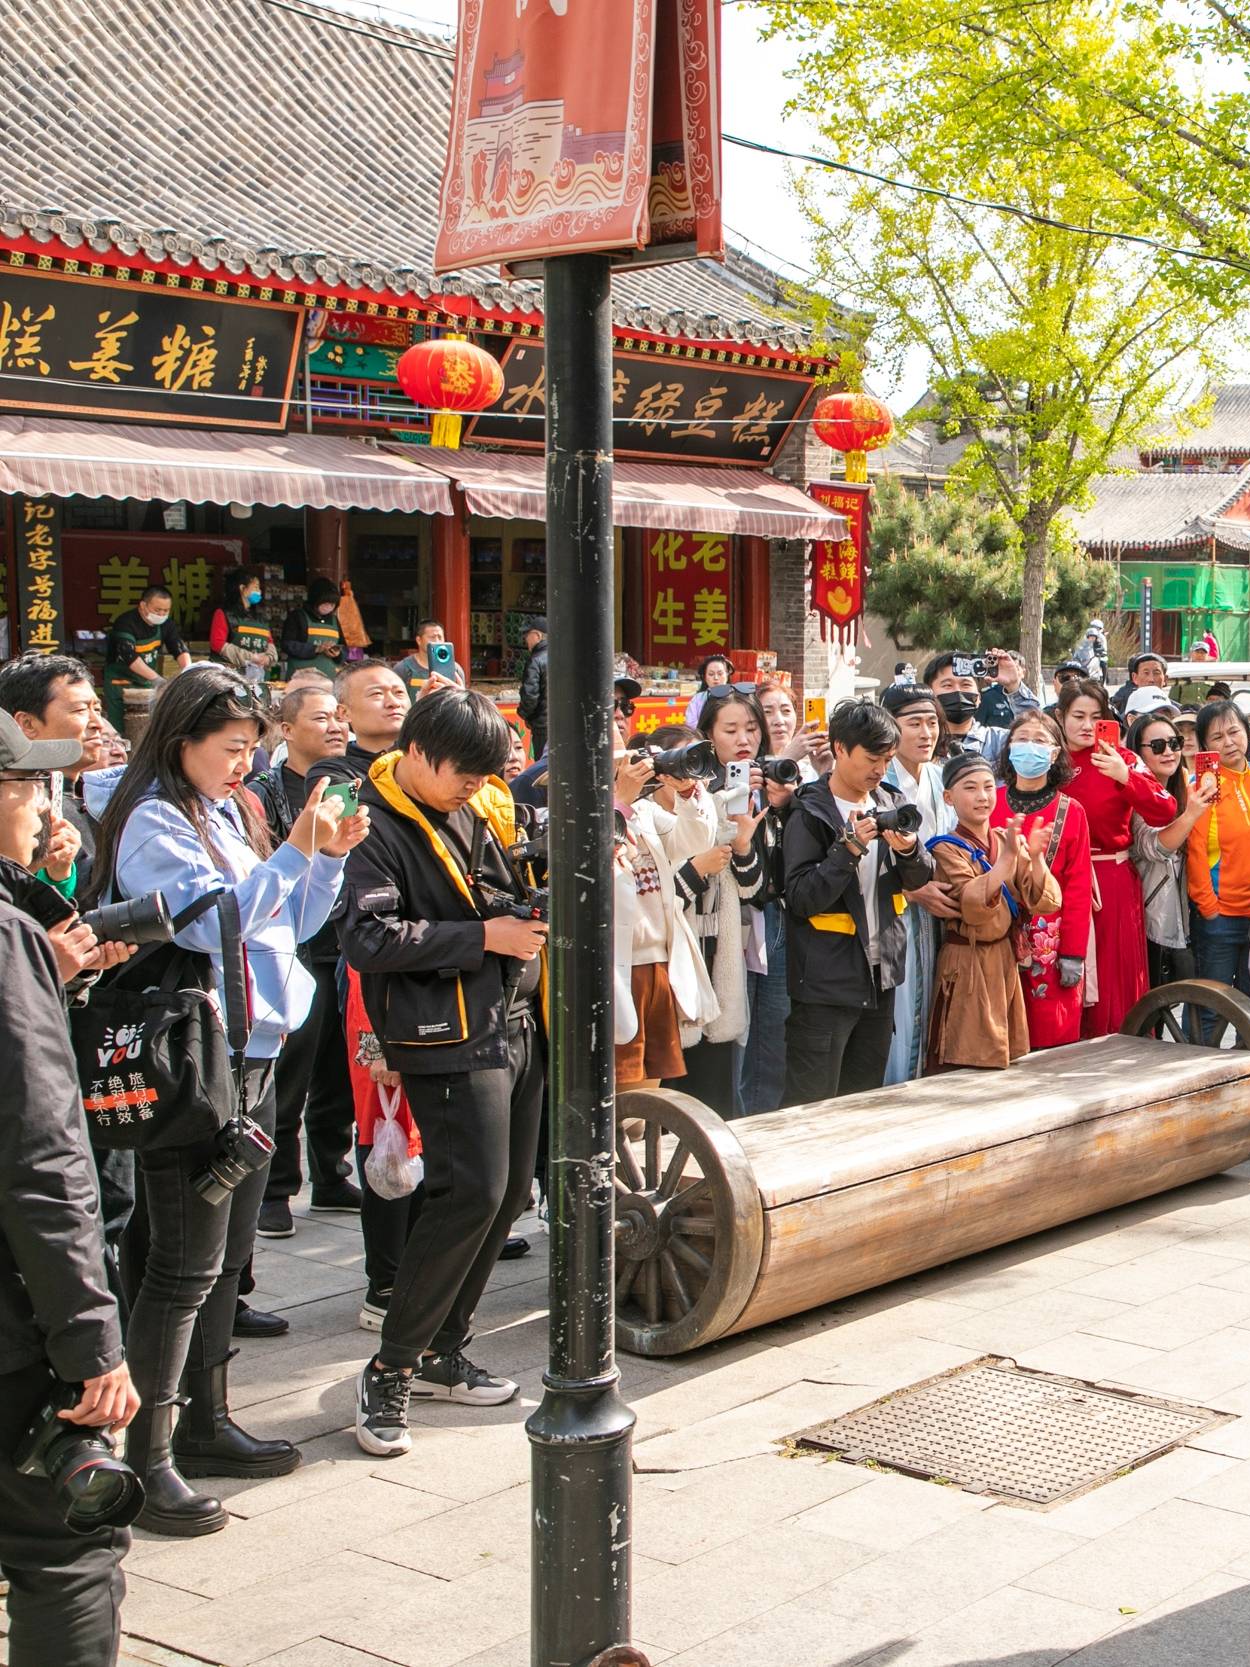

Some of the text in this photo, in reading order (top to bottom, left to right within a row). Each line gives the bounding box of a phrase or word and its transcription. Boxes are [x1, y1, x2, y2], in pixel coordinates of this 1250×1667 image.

[503, 364, 785, 445] 水绿豆糕
[24, 501, 60, 654] 记老字号福进
[97, 1040, 142, 1067] YOU
[108, 1075, 135, 1124] 绝对高效
[128, 1072, 154, 1120] 旅行必备
